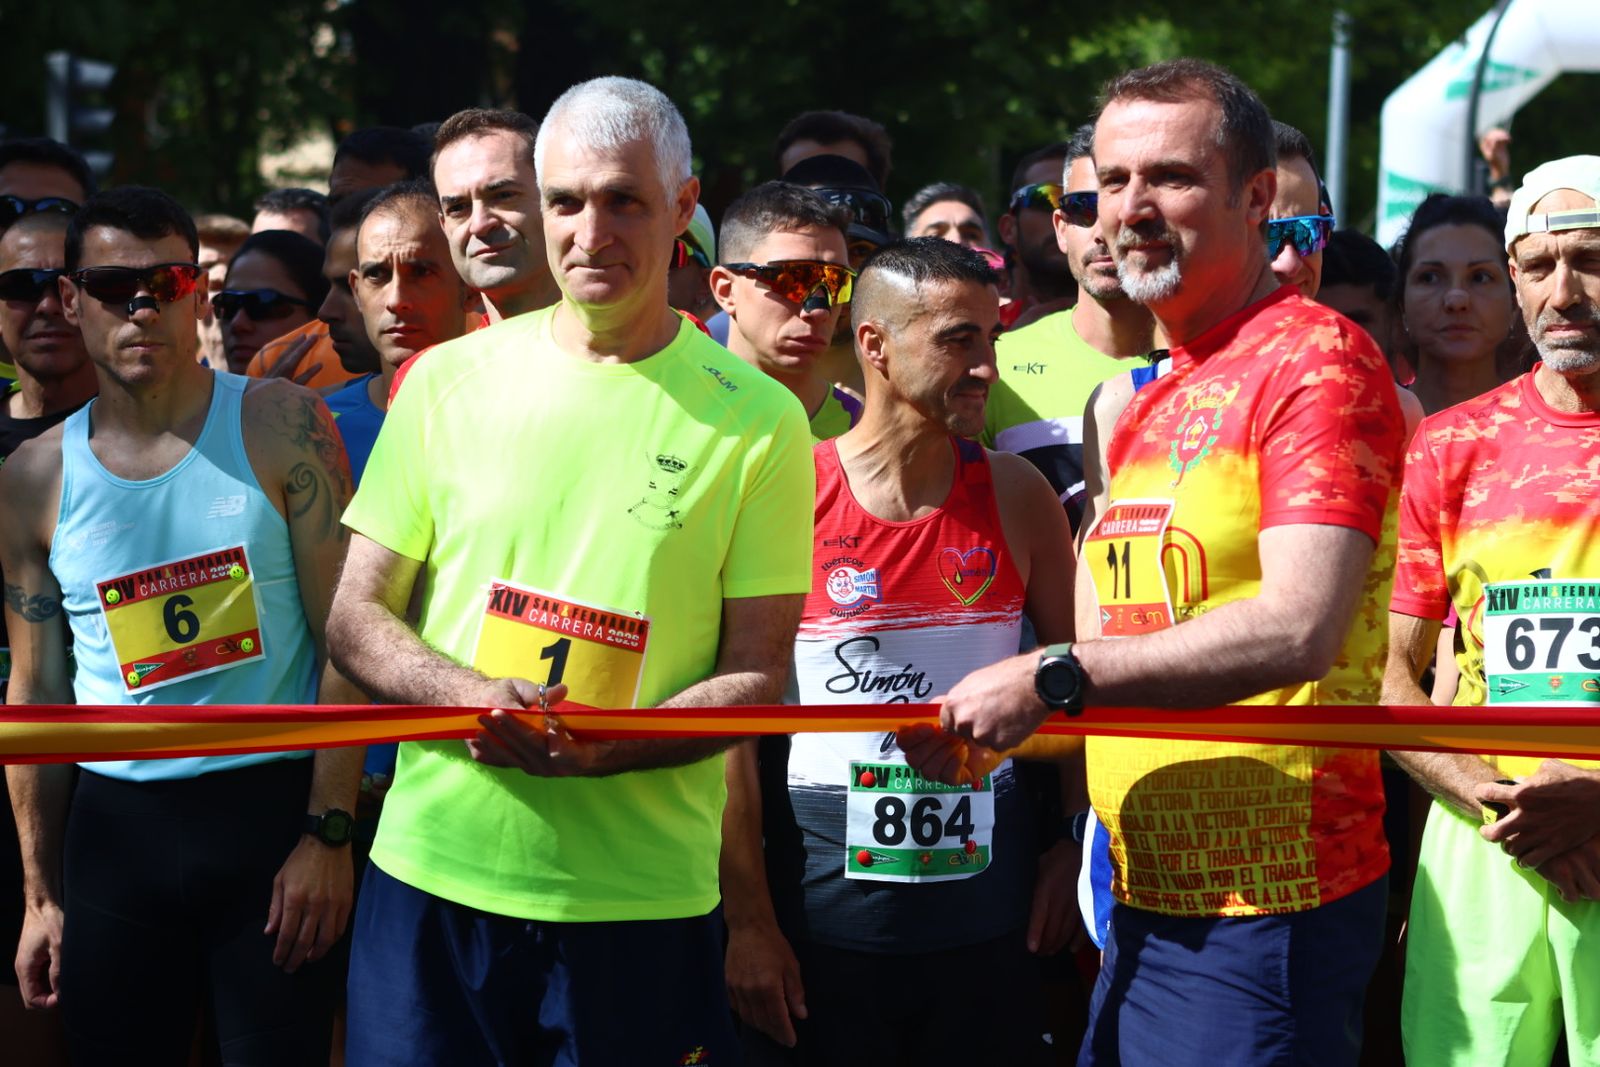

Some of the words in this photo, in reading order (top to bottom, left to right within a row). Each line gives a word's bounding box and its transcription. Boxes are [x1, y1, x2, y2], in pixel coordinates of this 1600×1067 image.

[174, 550, 241, 575] FERNANDO
[1106, 541, 1131, 599] 11
[140, 569, 208, 597] CARRERA
[489, 588, 531, 617] XIV
[533, 597, 560, 613] SAN
[572, 607, 645, 635] FERNANDO
[1487, 588, 1520, 611] XIV
[1524, 586, 1549, 598] SAN
[1562, 585, 1600, 597] FERN
[1523, 597, 1595, 610] CARRERA
[163, 594, 200, 644] 6
[528, 608, 603, 639] CARRERA
[1505, 617, 1600, 671] 673
[540, 638, 572, 688] 1
[825, 635, 933, 699] Simón
[1144, 770, 1214, 791] FORTALEZA
[1137, 793, 1193, 812] VICTORIA
[1199, 789, 1271, 811] FORTALEZA
[872, 795, 975, 847] 864
[1161, 814, 1169, 830] A
[1173, 813, 1188, 831] LA
[1192, 809, 1249, 831] VICTORIA
[1154, 831, 1210, 852] TRABAJO
[1215, 831, 1223, 848] A
[1228, 830, 1242, 848] LA
[1247, 825, 1304, 848] VICTORIA
[1159, 853, 1182, 871] POR
[1187, 852, 1200, 870] EL
[1206, 847, 1263, 868] TRABAJO
[1269, 847, 1278, 862] A
[1283, 844, 1297, 861] LA
[1171, 872, 1205, 890] VALOR
[1208, 869, 1235, 889] POR
[1240, 866, 1256, 886] EL
[1261, 860, 1317, 883] TRABAJO
[1184, 893, 1199, 911] EL
[1201, 888, 1257, 910] TRABAJO
[1263, 887, 1272, 904] A
[1276, 885, 1292, 904] LA
